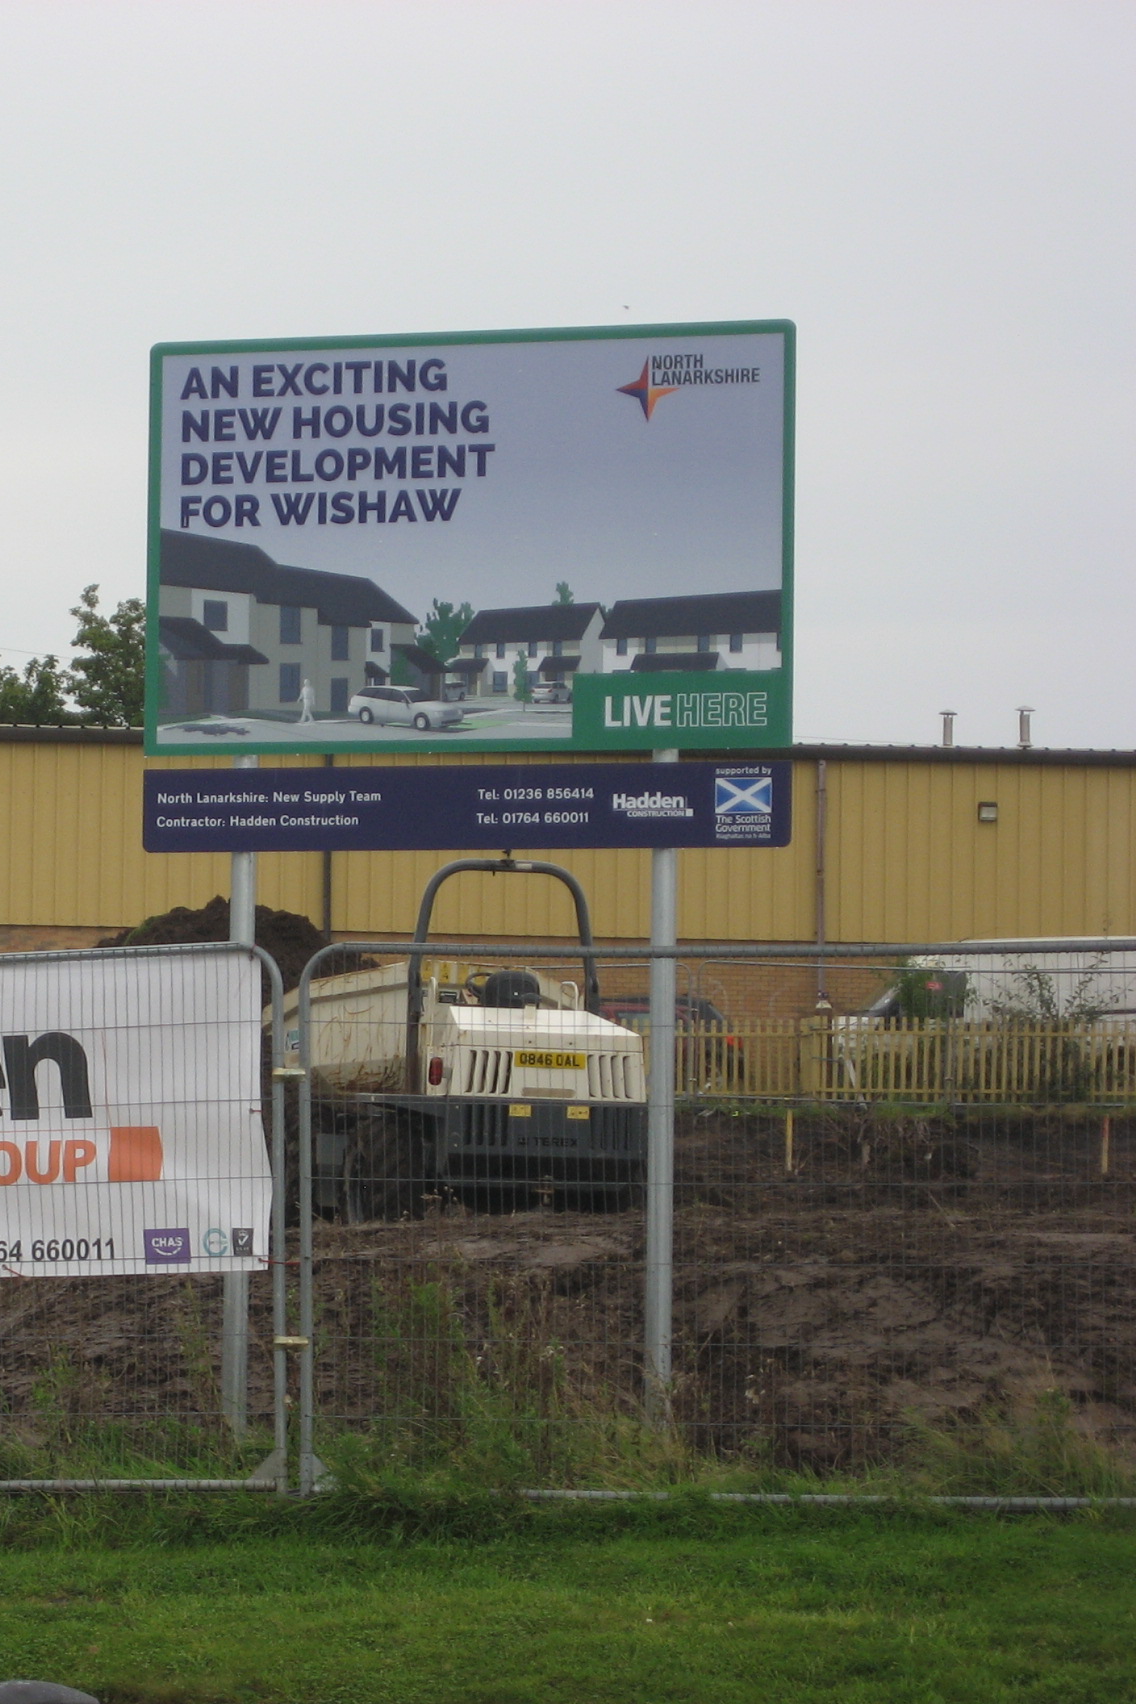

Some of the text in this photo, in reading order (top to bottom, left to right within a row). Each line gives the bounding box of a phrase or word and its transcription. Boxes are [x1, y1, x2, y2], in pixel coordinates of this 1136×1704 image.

[652, 354, 704, 370] NORTH
[180, 358, 448, 400] AN EXCITING
[652, 368, 761, 386] LANARKSHIRE
[181, 400, 490, 442] NEW HOUSING
[181, 444, 496, 485] DEVELOPMENT
[180, 488, 462, 528] FOR WISHAW
[604, 692, 768, 728] LIVE HERE
[715, 766, 772, 775] supported by
[157, 790, 382, 804] North Lanarkshire: New Supply Team
[477, 787, 594, 800] Tel: 01236 856414
[613, 791, 685, 809] Hadden
[476, 812, 589, 824] Tel: 01764 660011
[627, 809, 685, 817] CONSTRUCTION
[716, 814, 772, 823] The Scottish
[156, 814, 359, 827] Contractor: Hadden Construction
[715, 824, 771, 832] Government
[534, 1137, 578, 1147] TEREX
[152, 1237, 183, 1247] CHAS
[31, 1238, 116, 1262] 660011
